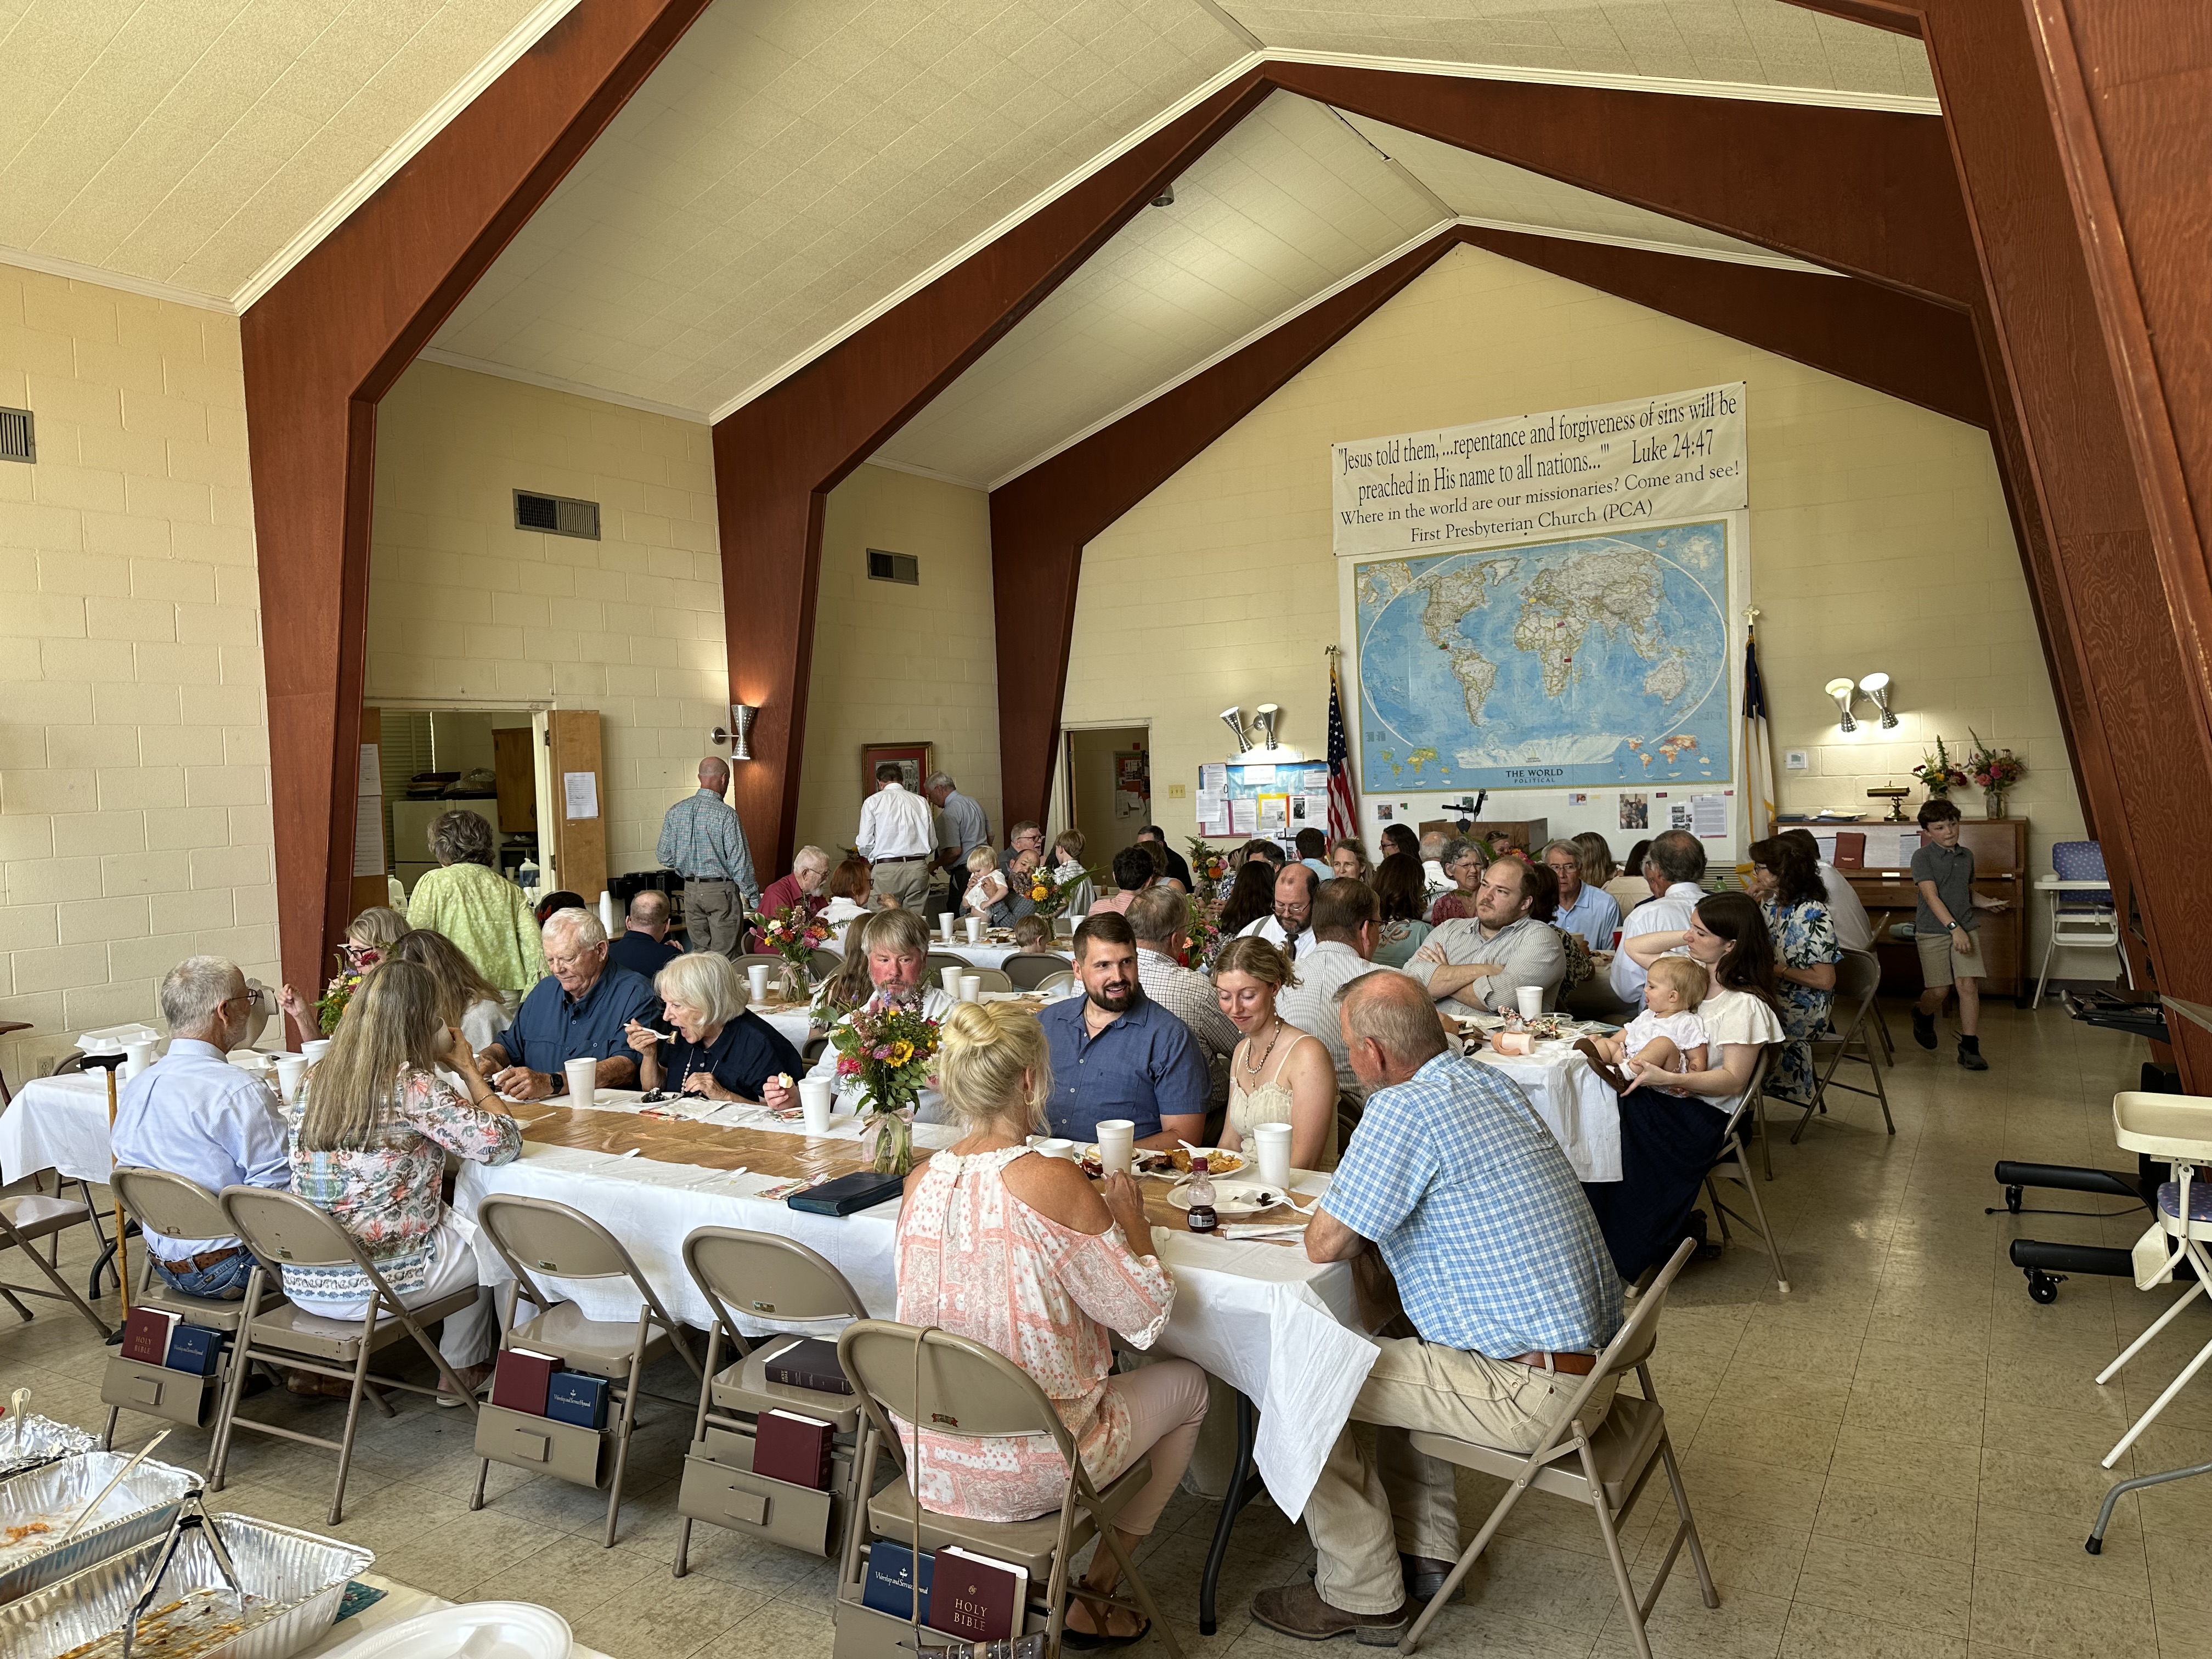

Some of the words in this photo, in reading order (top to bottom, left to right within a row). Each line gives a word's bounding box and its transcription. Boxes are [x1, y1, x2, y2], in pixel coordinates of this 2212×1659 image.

[1339, 448, 1372, 476] "Jesus
[1376, 439, 1400, 466] told
[1530, 416, 1555, 444] and
[1560, 414, 1635, 443] forgiveness
[1640, 401, 1655, 427] of
[1658, 403, 1684, 425] sins
[1689, 392, 1714, 420] will
[1719, 390, 1736, 415] be
[1359, 471, 1413, 506] preached
[1418, 472, 1430, 493] in
[1434, 467, 1455, 491] His
[1459, 468, 1495, 488] name
[1500, 465, 1513, 482] to
[1517, 453, 1533, 480] all
[1632, 436, 1667, 464] Luke
[1673, 429, 1713, 459] 24:47
[1341, 510, 1384, 526] Where
[1388, 507, 1401, 520] in
[1406, 503, 1425, 518] the
[1430, 496, 1467, 515] world
[1472, 499, 1493, 511] are
[1497, 495, 1521, 507] our
[1526, 477, 1619, 504] missionaries?
[1625, 474, 1670, 490] Come
[1675, 464, 1704, 484] and
[1709, 460, 1739, 479] see!
[1411, 528, 1441, 542] First
[1446, 517, 1533, 539] Presbyterian
[1538, 506, 1597, 527] Church
[1603, 498, 1652, 522] (PCA)
[1506, 770, 1525, 778] THE
[1528, 769, 1563, 777] WORLD
[134, 1345, 151, 1355] BIBLE
[136, 1336, 152, 1345] HOLY
[875, 1571, 892, 1585] Worship
[899, 1578, 913, 1590] Service
[955, 1598, 988, 1617] HOLY
[953, 1612, 986, 1632] BIBLE
